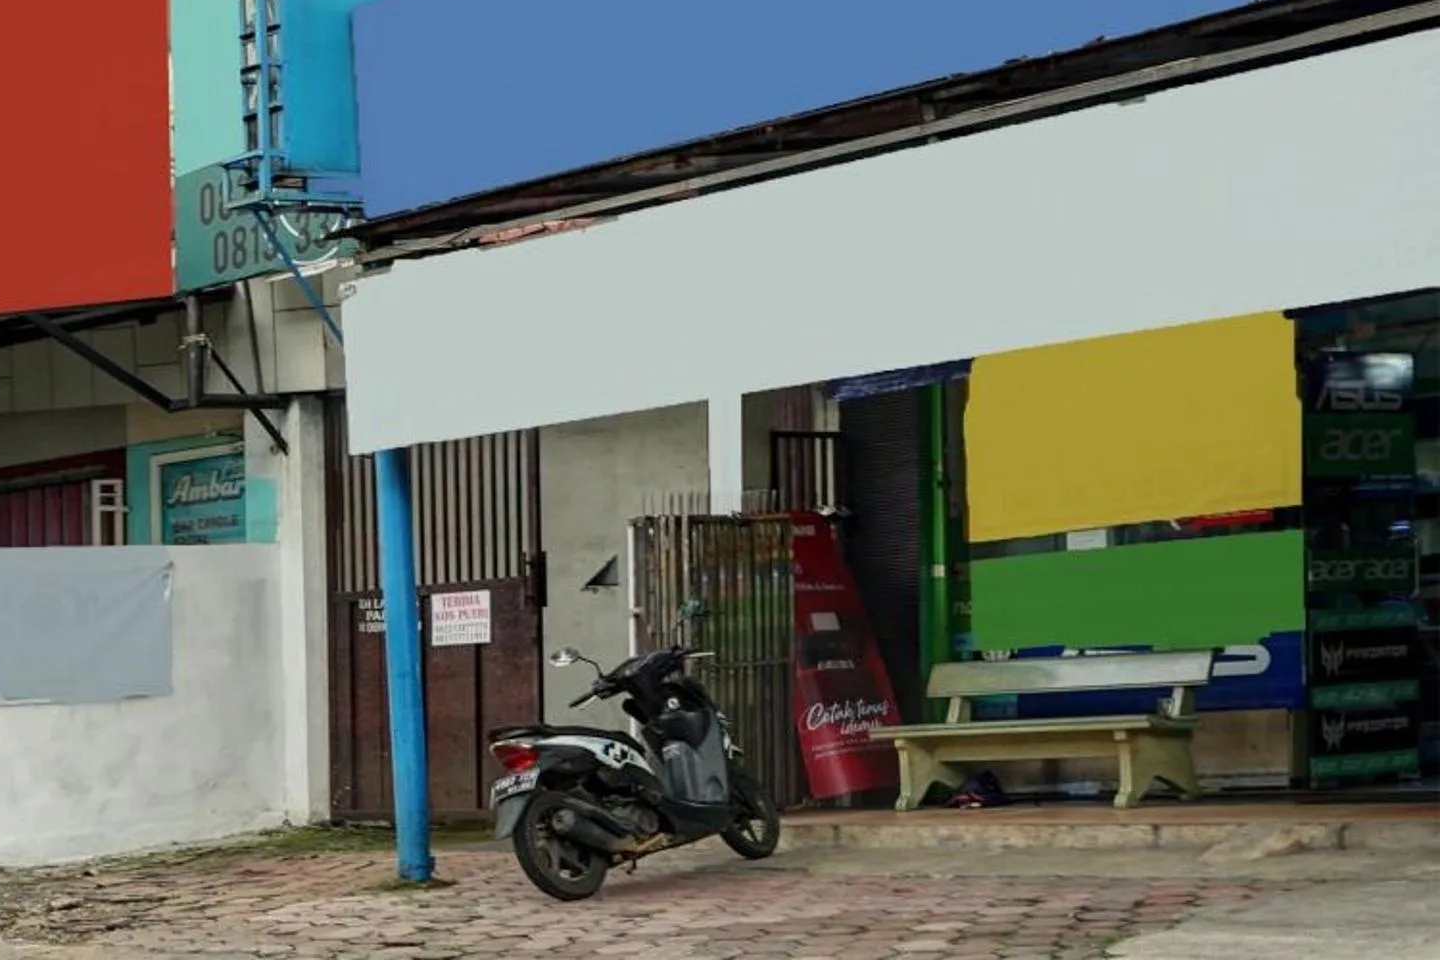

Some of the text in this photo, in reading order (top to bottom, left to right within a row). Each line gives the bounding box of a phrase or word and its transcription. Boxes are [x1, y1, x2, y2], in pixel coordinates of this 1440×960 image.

[1321, 428, 1403, 461] acer
[167, 470, 246, 505] Ambar
[1312, 558, 1362, 581] acer
